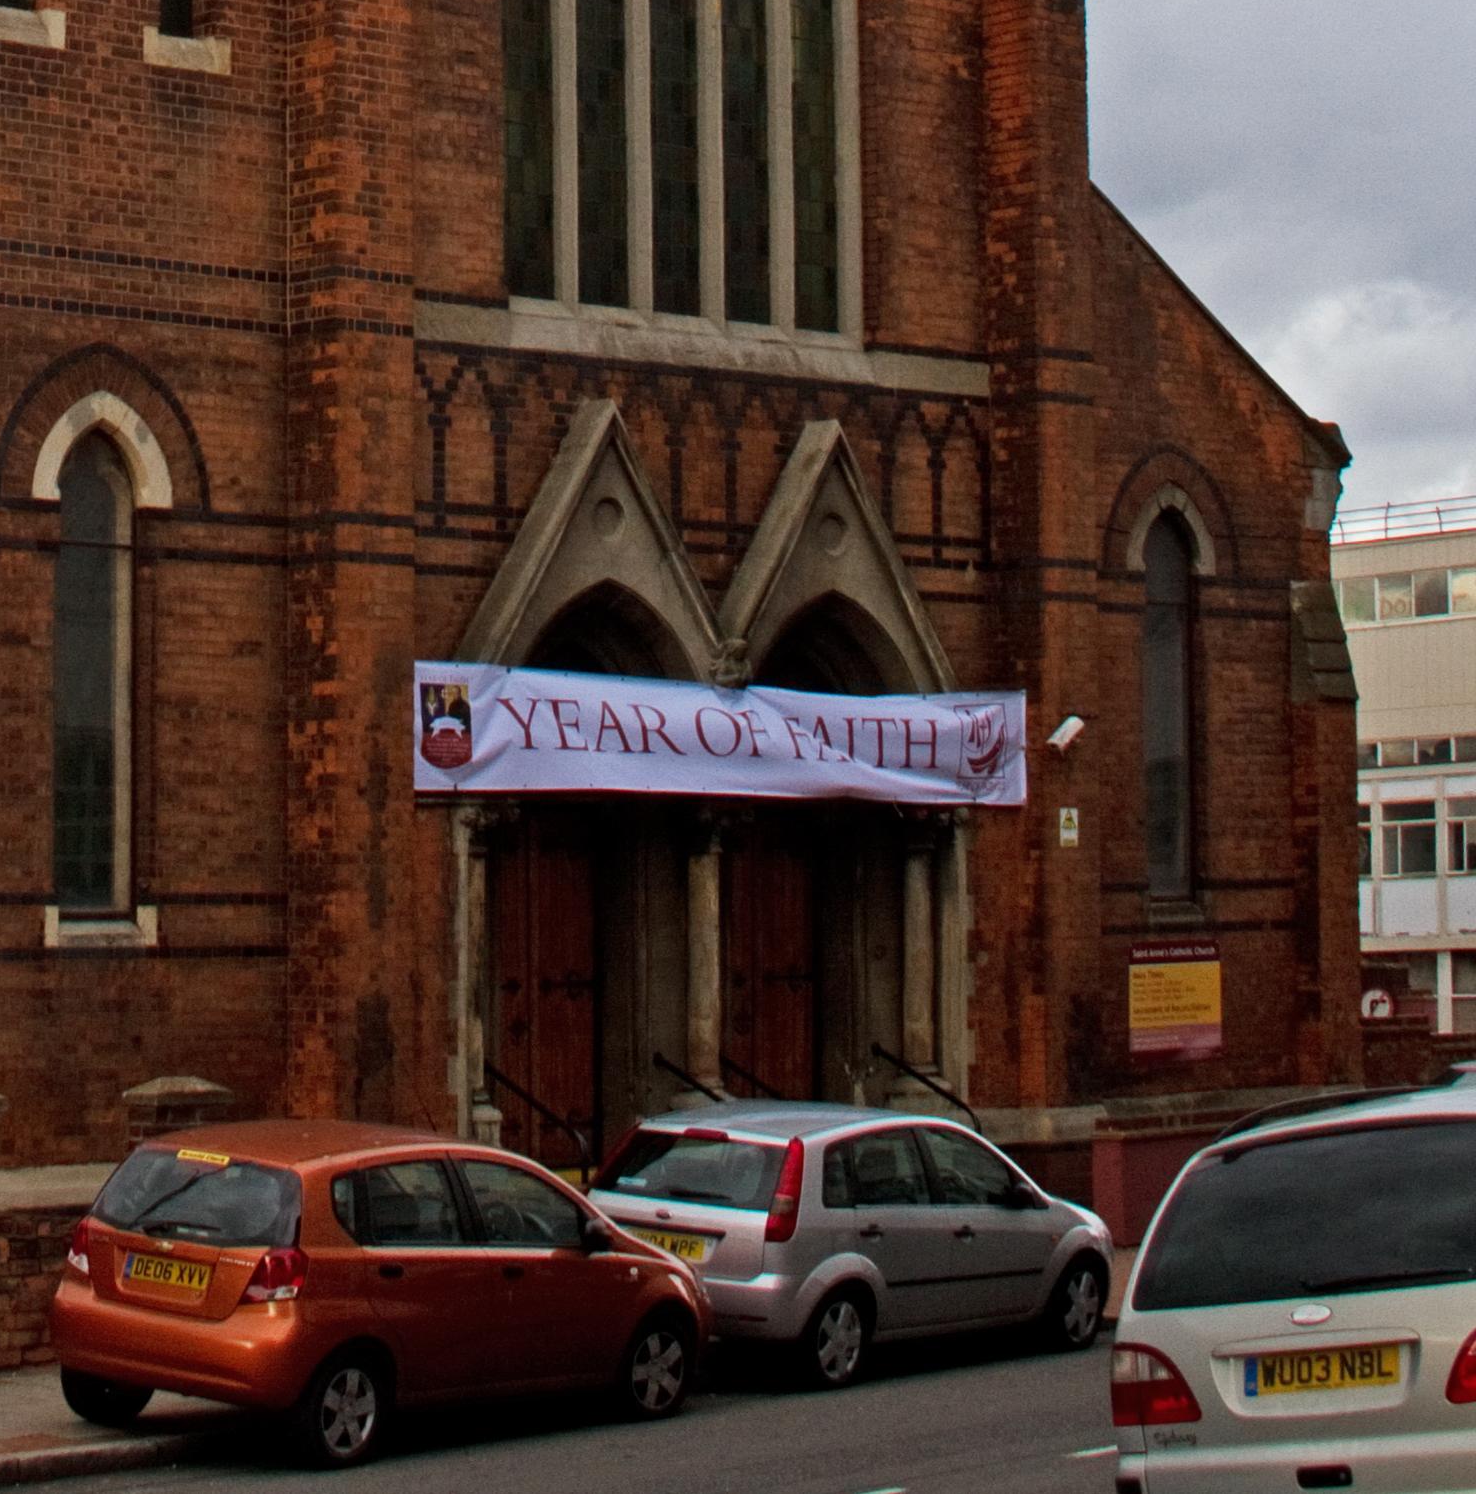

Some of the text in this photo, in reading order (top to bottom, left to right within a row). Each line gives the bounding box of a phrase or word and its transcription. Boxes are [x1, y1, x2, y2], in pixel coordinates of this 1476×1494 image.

[496, 698, 687, 755] YEAR
[694, 707, 770, 757] OF
[782, 716, 939, 768] FAITH
[1132, 948, 1148, 958] Saint
[1169, 946, 1193, 956] Catholic
[1194, 946, 1216, 955] Church
[134, 1257, 209, 1286] DE06 XVV
[1260, 1349, 1394, 1388] WU03 NBL
